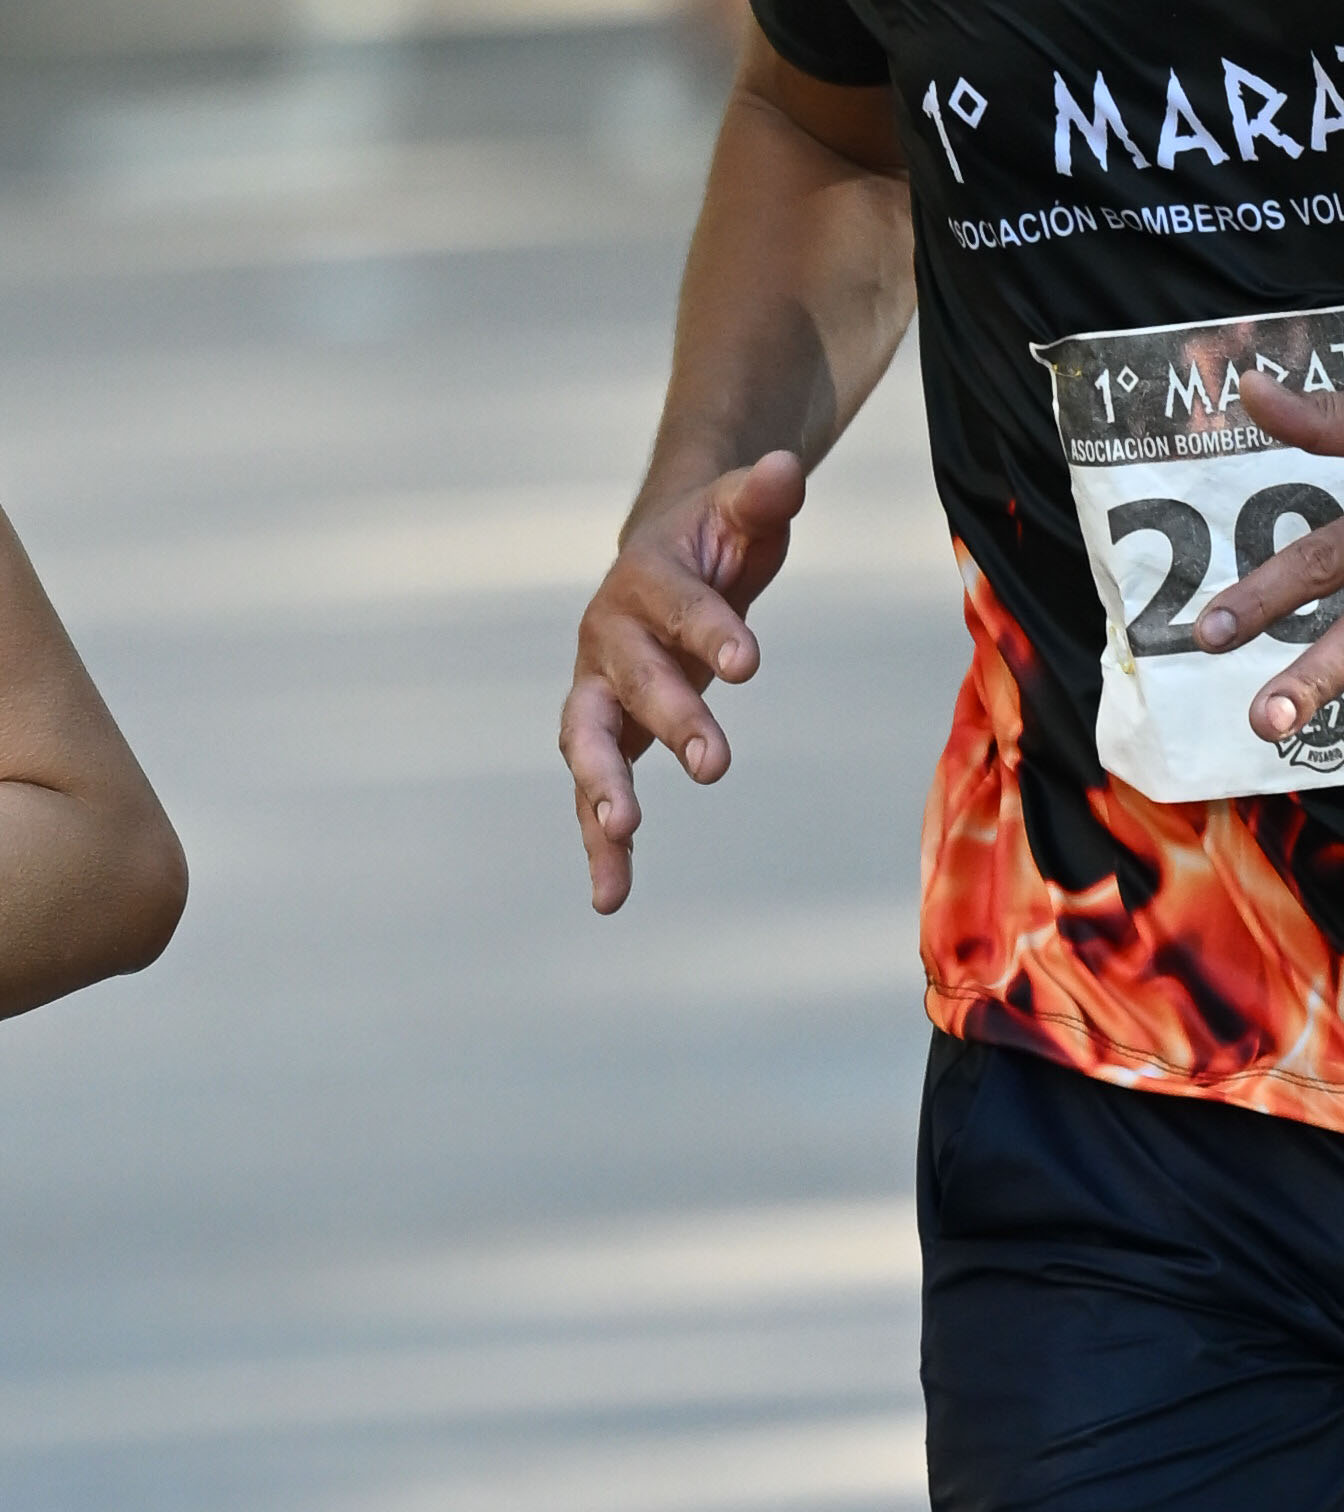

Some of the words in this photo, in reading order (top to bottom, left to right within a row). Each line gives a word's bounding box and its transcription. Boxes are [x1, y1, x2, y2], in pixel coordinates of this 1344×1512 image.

[1053, 45, 1344, 177] MARA
[1101, 199, 1286, 236] BOMBEROS
[1070, 432, 1170, 462] ASOCIACIÓN
